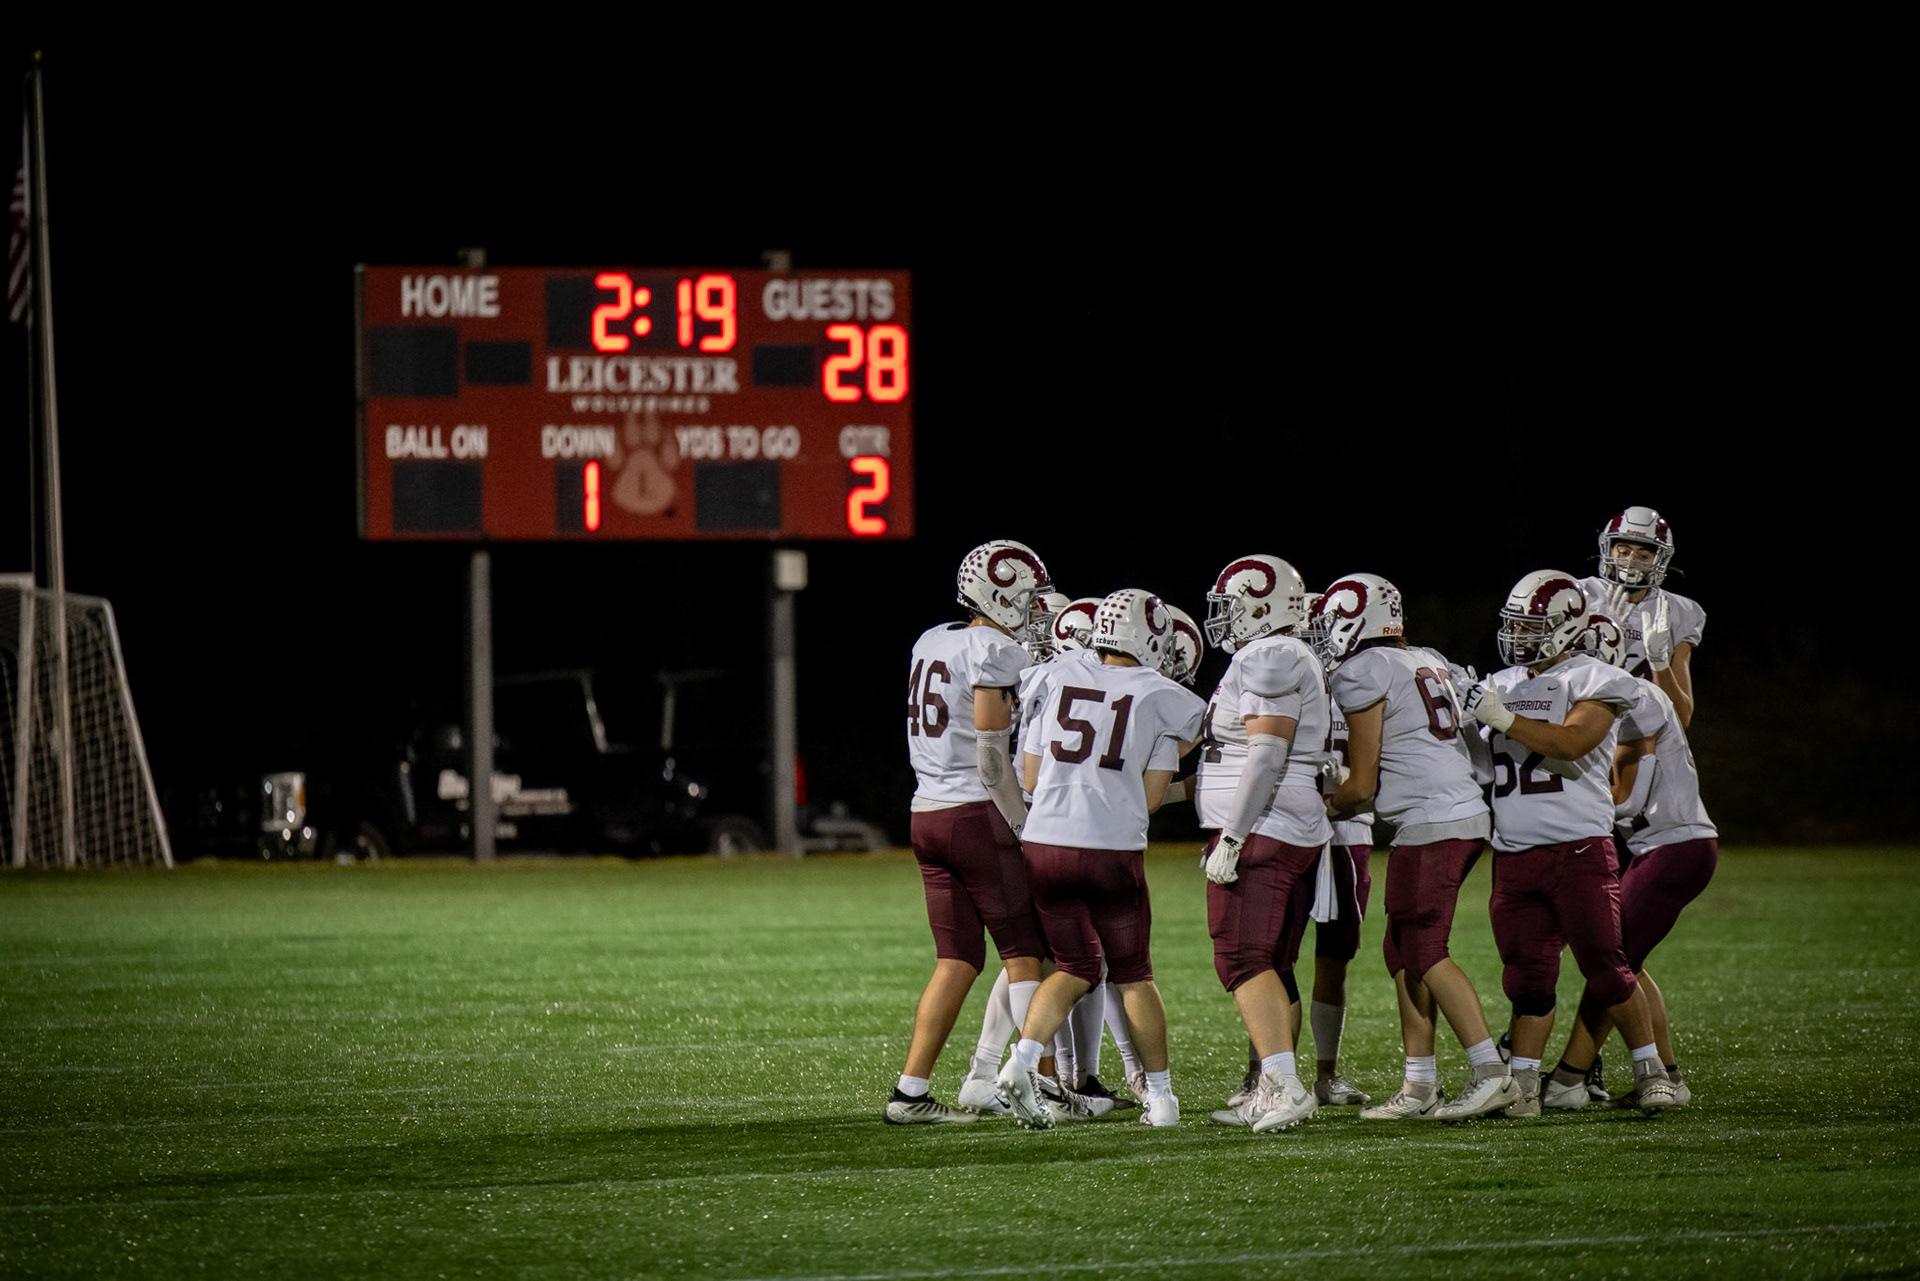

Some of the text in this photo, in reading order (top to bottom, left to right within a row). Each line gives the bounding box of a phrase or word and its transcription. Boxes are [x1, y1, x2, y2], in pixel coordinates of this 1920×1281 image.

[400, 274, 500, 318] HOME
[591, 272, 738, 352] 2:19
[762, 278, 896, 321] GUESTS
[546, 355, 740, 394] LEICESTER
[822, 324, 909, 403] 28
[386, 425, 488, 459] BALL ON
[541, 425, 615, 459] DOWN
[675, 425, 800, 459] YDS TO GO
[582, 460, 600, 532] 1
[847, 456, 890, 536] 2
[1100, 617, 1115, 635] 51
[908, 658, 950, 738] 46
[1050, 685, 1134, 772] 51
